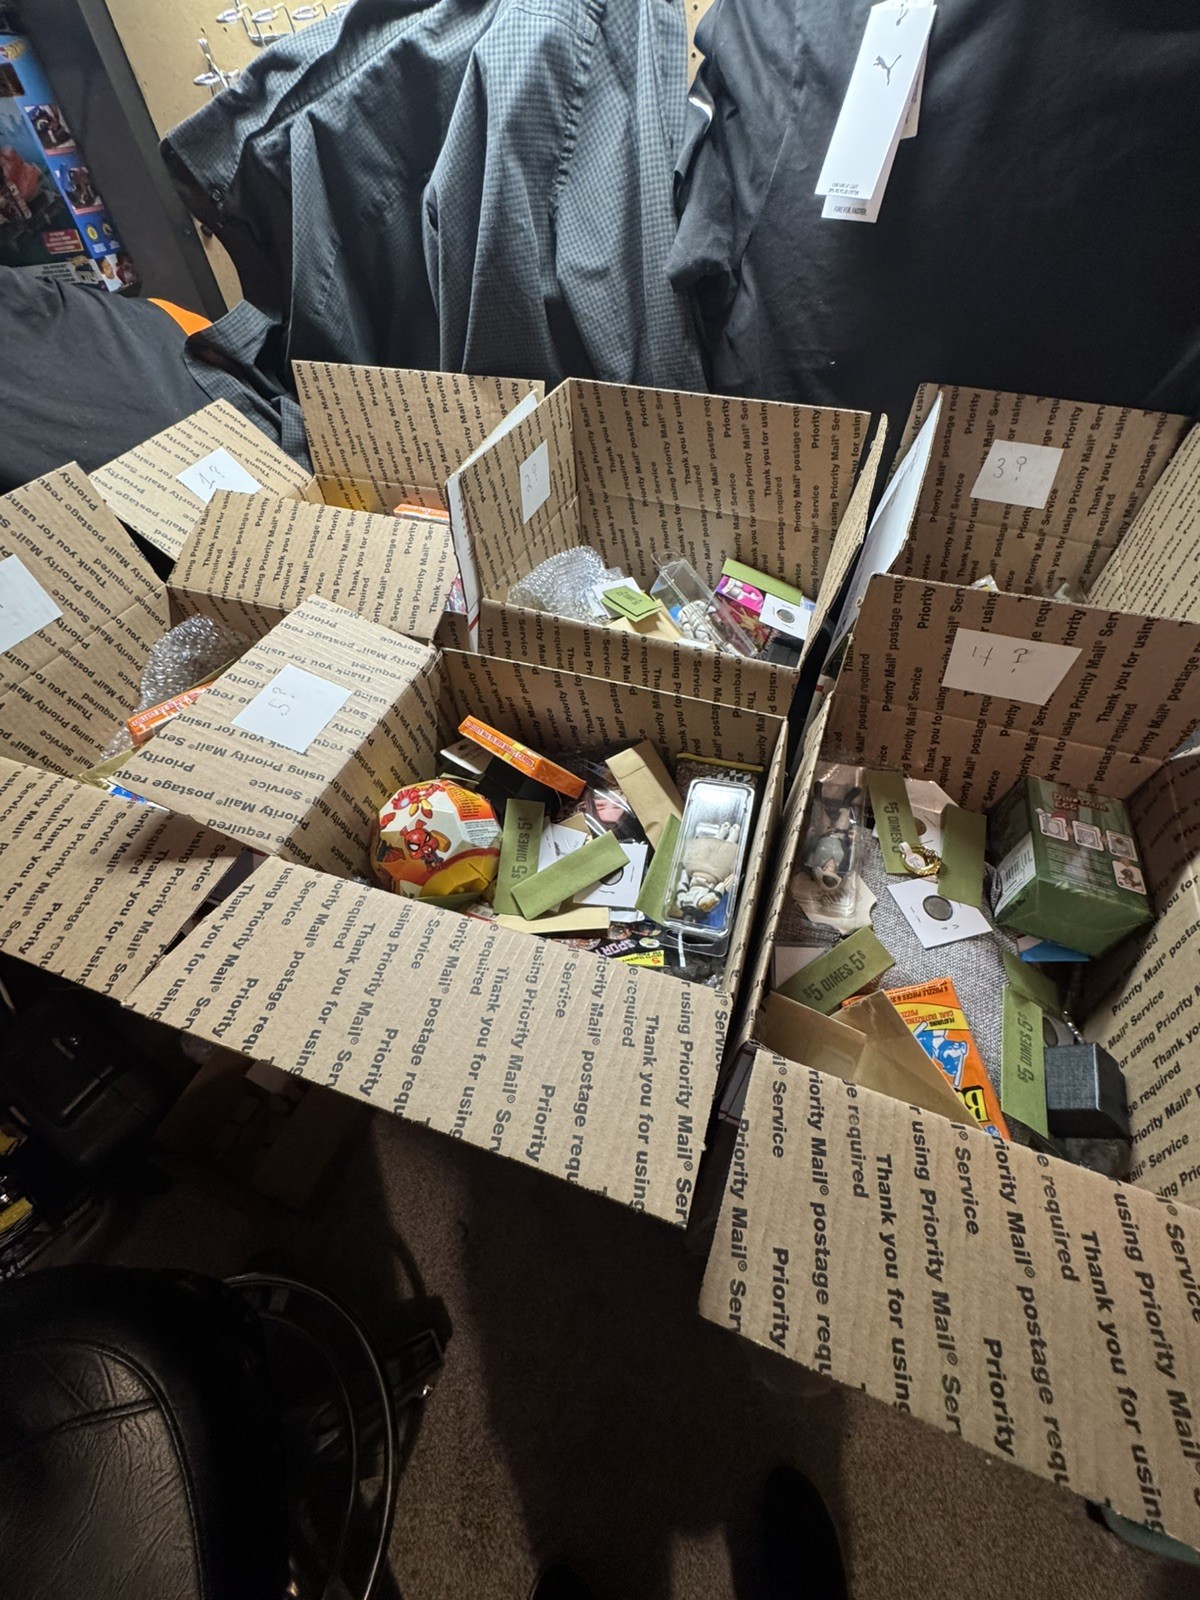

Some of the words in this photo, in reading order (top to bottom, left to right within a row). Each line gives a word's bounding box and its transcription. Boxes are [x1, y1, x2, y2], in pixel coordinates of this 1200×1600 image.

[724, 399, 732, 438] Priority
[811, 409, 821, 450] Priority
[964, 393, 981, 435] Priority
[1063, 406, 1083, 449] Priority
[792, 430, 801, 471] postage
[5, 494, 37, 522] using
[59, 472, 99, 512] Priority
[812, 485, 820, 520] Service
[951, 472, 965, 510] Service
[1087, 480, 1104, 518] Thank
[65, 504, 106, 543] postage
[255, 496, 270, 527] Priority
[327, 509, 342, 541] Priority
[794, 502, 802, 533] Priority
[404, 522, 418, 555] Priority
[439, 550, 447, 564] for
[77, 558, 107, 589] Thank
[413, 569, 427, 602] Priority
[437, 566, 445, 582] you
[52, 589, 90, 623] Service
[390, 587, 404, 622] Service
[409, 604, 420, 631] using
[429, 585, 441, 614] Thank
[916, 585, 936, 630] Priority
[1122, 651, 1140, 669] for
[909, 666, 923, 703] Service
[1114, 670, 1132, 692] you
[1096, 692, 1121, 722] Thank
[1111, 703, 1138, 742] required
[1130, 729, 1159, 764] Priority
[1167, 656, 1199, 701] postage
[138, 749, 196, 774] Priority
[229, 748, 284, 773] Priority
[287, 763, 326, 783] using
[151, 778, 215, 803] postage
[248, 778, 304, 801] Service
[42, 819, 72, 852] Thank
[90, 812, 127, 855] Service
[206, 816, 271, 844] required
[258, 804, 311, 832] Priority
[19, 856, 41, 878] you
[48, 833, 85, 878] Priority
[130, 823, 167, 874] required
[137, 847, 171, 887] Thank
[191, 842, 226, 891] Service
[515, 832, 530, 863] DIMES
[265, 868, 293, 898] using
[63, 877, 105, 931] postage
[119, 891, 140, 916] you
[219, 885, 255, 921] Thank
[281, 880, 317, 926] Service
[333, 895, 367, 949] required
[19, 903, 63, 955] Priority
[105, 921, 124, 942] for
[200, 924, 224, 949] you
[232, 902, 273, 950] Priority
[345, 923, 376, 964] Thank
[411, 919, 440, 969] Service
[184, 953, 206, 975] for
[265, 951, 305, 1011] postage
[820, 963, 854, 992] DIMES
[212, 978, 259, 1038] Priority
[487, 967, 510, 1013] Thank
[555, 962, 576, 1018] Service
[1108, 982, 1142, 1017] Priority
[1130, 990, 1164, 1026] Service
[476, 1017, 493, 1048] you
[511, 988, 538, 1050] Priority
[622, 985, 637, 1048] required
[900, 1009, 918, 1017] PUZZL
[642, 1015, 659, 1067] Thank
[1019, 1030, 1032, 1067] DIMES
[1152, 1038, 1184, 1069] Thank
[468, 1054, 487, 1081] for
[676, 1040, 693, 1109] Priority
[1139, 1061, 1181, 1104] required
[573, 1050, 595, 1127] postage
[639, 1072, 653, 1107] you
[526, 1084, 556, 1163] Priority
[638, 1113, 654, 1145] for
[772, 1081, 787, 1158] Service
[730, 1117, 749, 1200] Priority
[846, 1105, 869, 1199] required
[912, 1121, 930, 1181] using
[1149, 1134, 1189, 1168] Service
[876, 1154, 896, 1225] Thank
[955, 1146, 979, 1235] Service
[919, 1188, 944, 1283] Priority
[1041, 1175, 1080, 1282] required
[810, 1202, 830, 1305] postage
[879, 1232, 898, 1279] you
[1113, 1193, 1144, 1262] using
[1134, 1271, 1176, 1380] Priority
[1166, 1224, 1200, 1324] Service
[769, 1247, 790, 1352] Priority
[887, 1288, 905, 1329] for
[1016, 1285, 1053, 1405] postage
[1081, 1231, 1114, 1313] Thank
[1099, 1322, 1127, 1376] you
[1117, 1386, 1142, 1435] for
[983, 1338, 1015, 1461] Priority
